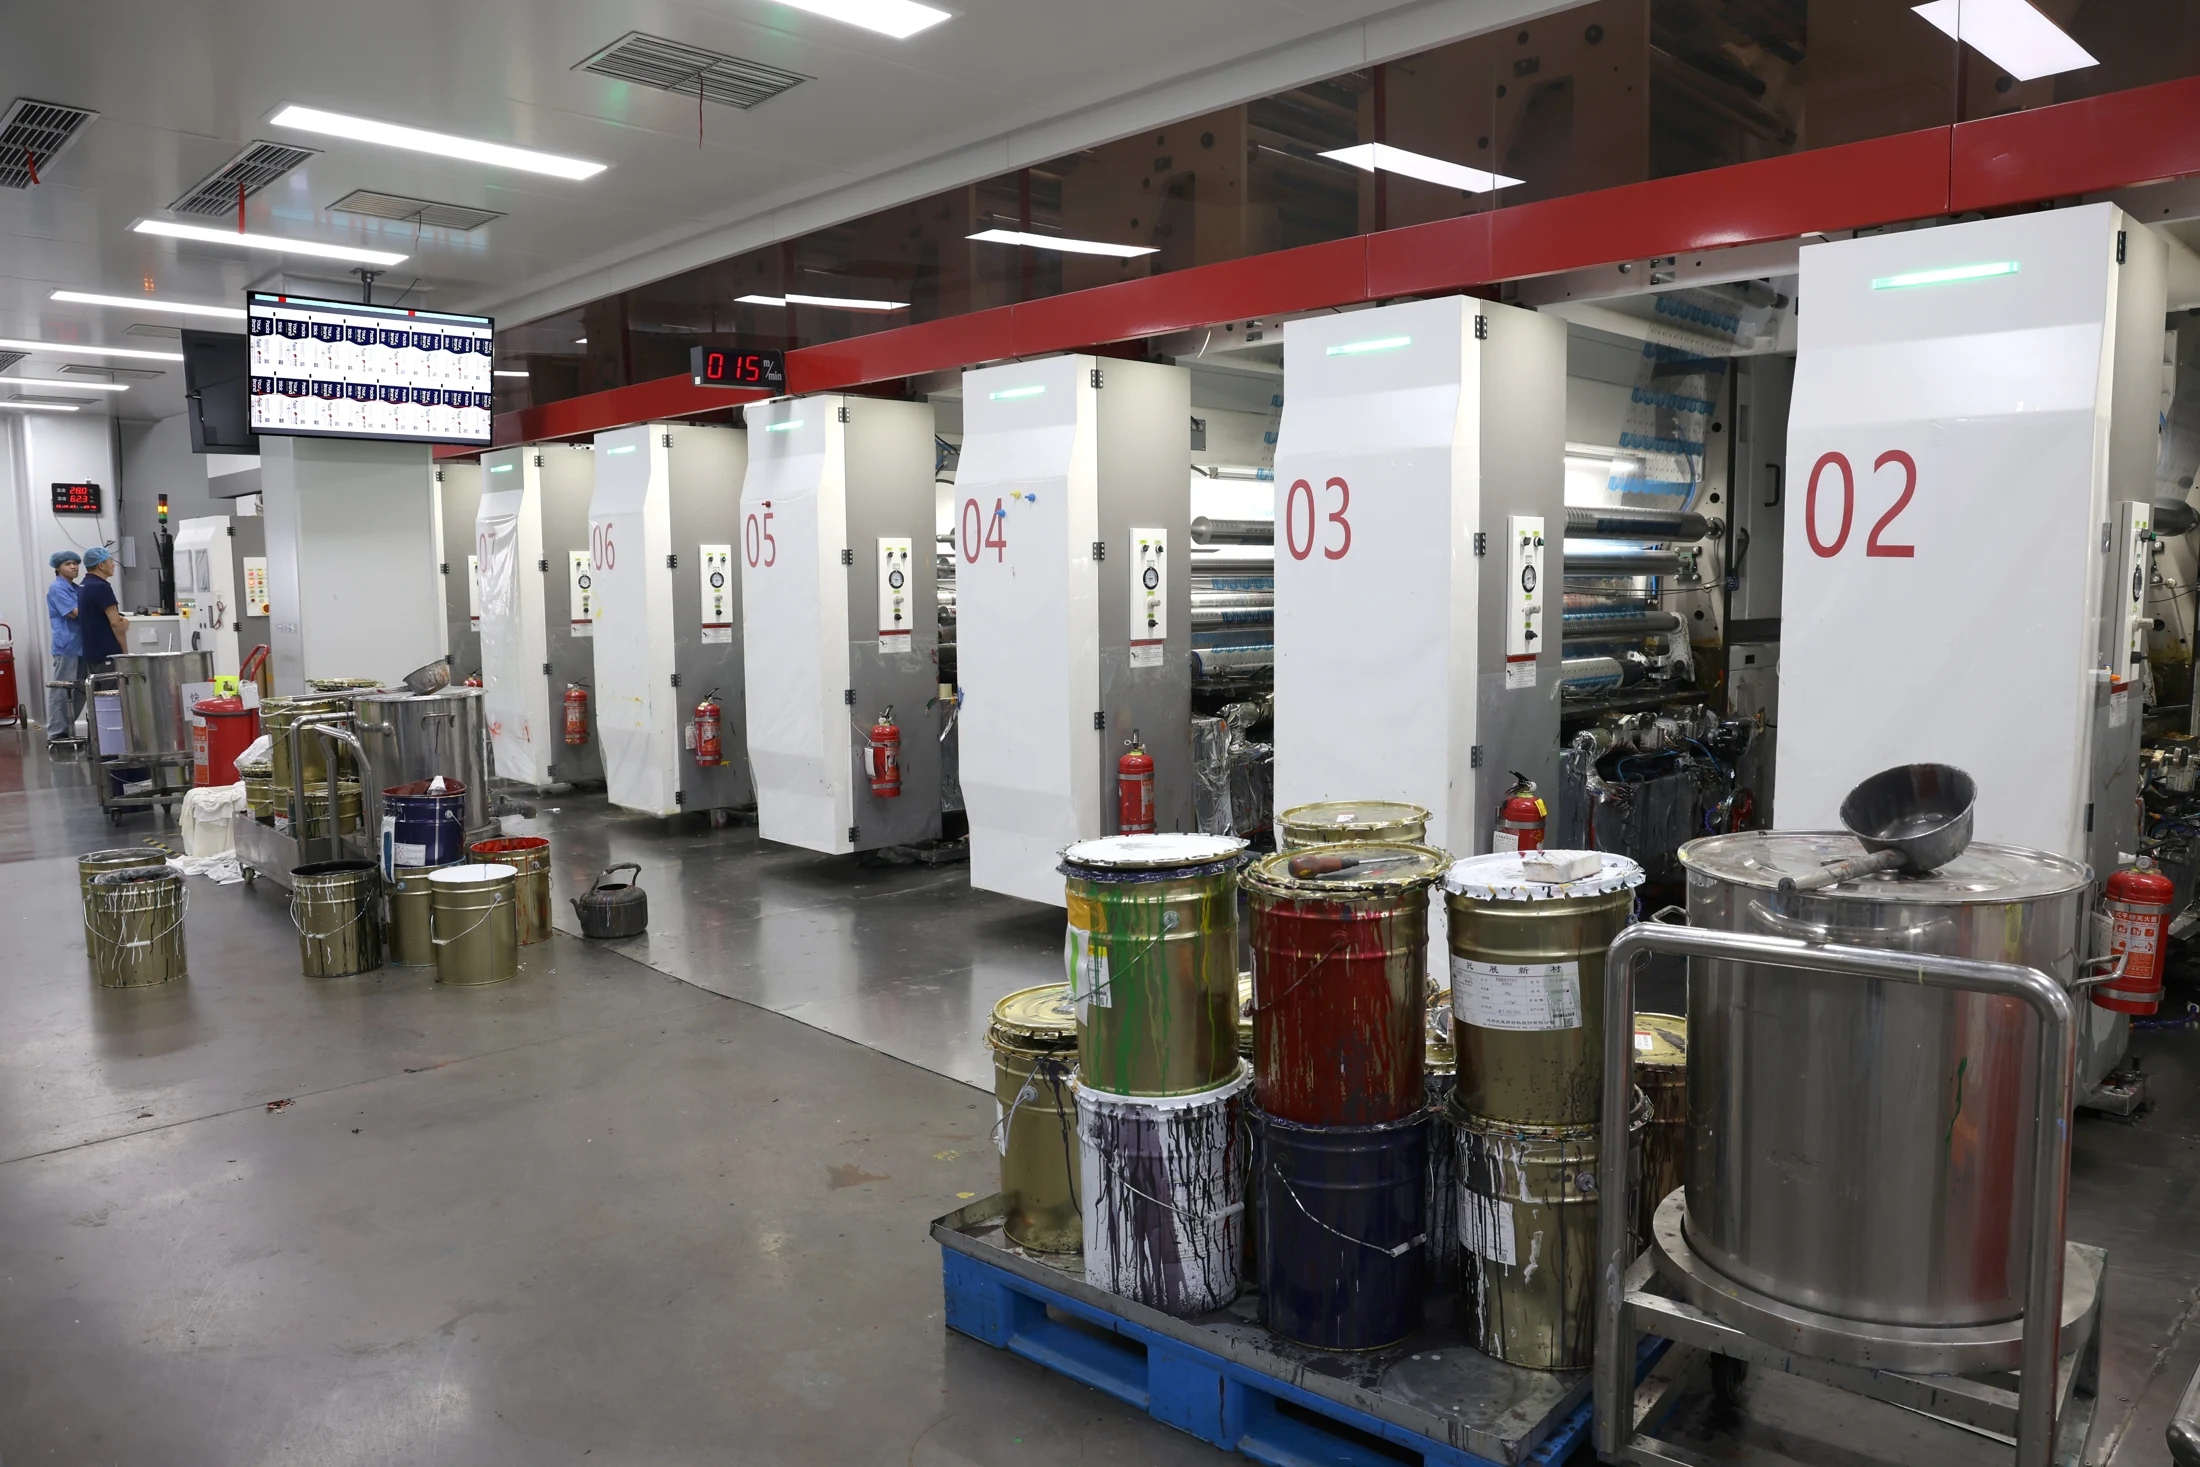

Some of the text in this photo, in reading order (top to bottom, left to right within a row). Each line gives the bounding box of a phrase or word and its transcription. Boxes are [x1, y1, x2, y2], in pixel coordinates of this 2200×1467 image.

[707, 354, 782, 380] 015 m/min
[962, 498, 1007, 564] 04
[1286, 477, 1351, 560] 03
[1806, 450, 1917, 558] 02
[592, 522, 616, 571] 06
[746, 512, 776, 568] 05
